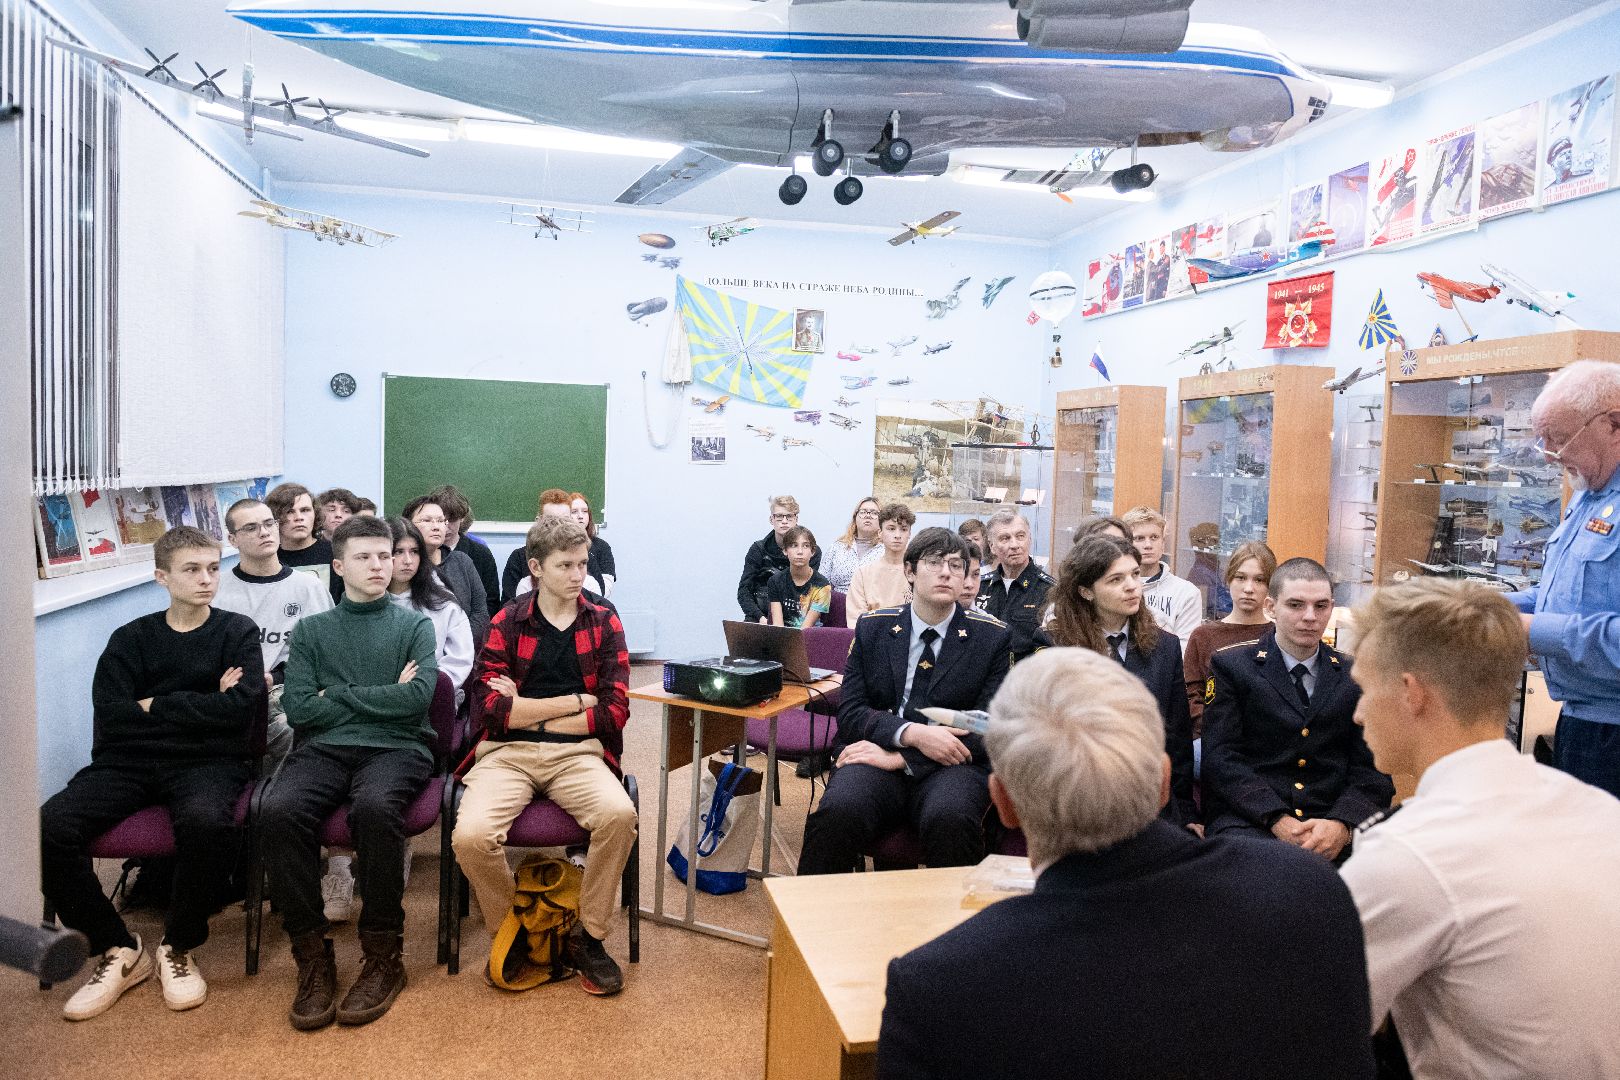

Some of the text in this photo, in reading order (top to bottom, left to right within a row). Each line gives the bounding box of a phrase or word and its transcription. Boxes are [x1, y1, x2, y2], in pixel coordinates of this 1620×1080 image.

[704, 277, 750, 288] ДОЛЬШЕ
[753, 279, 779, 289] ВЕКА
[782, 281, 796, 290] НА
[799, 282, 841, 292] СТРАЖЕ
[843, 285, 869, 294] НЕБА
[1274, 289, 1289, 300] 1941
[1308, 282, 1325, 294] 1945
[1426, 355, 1442, 365] МЫ
